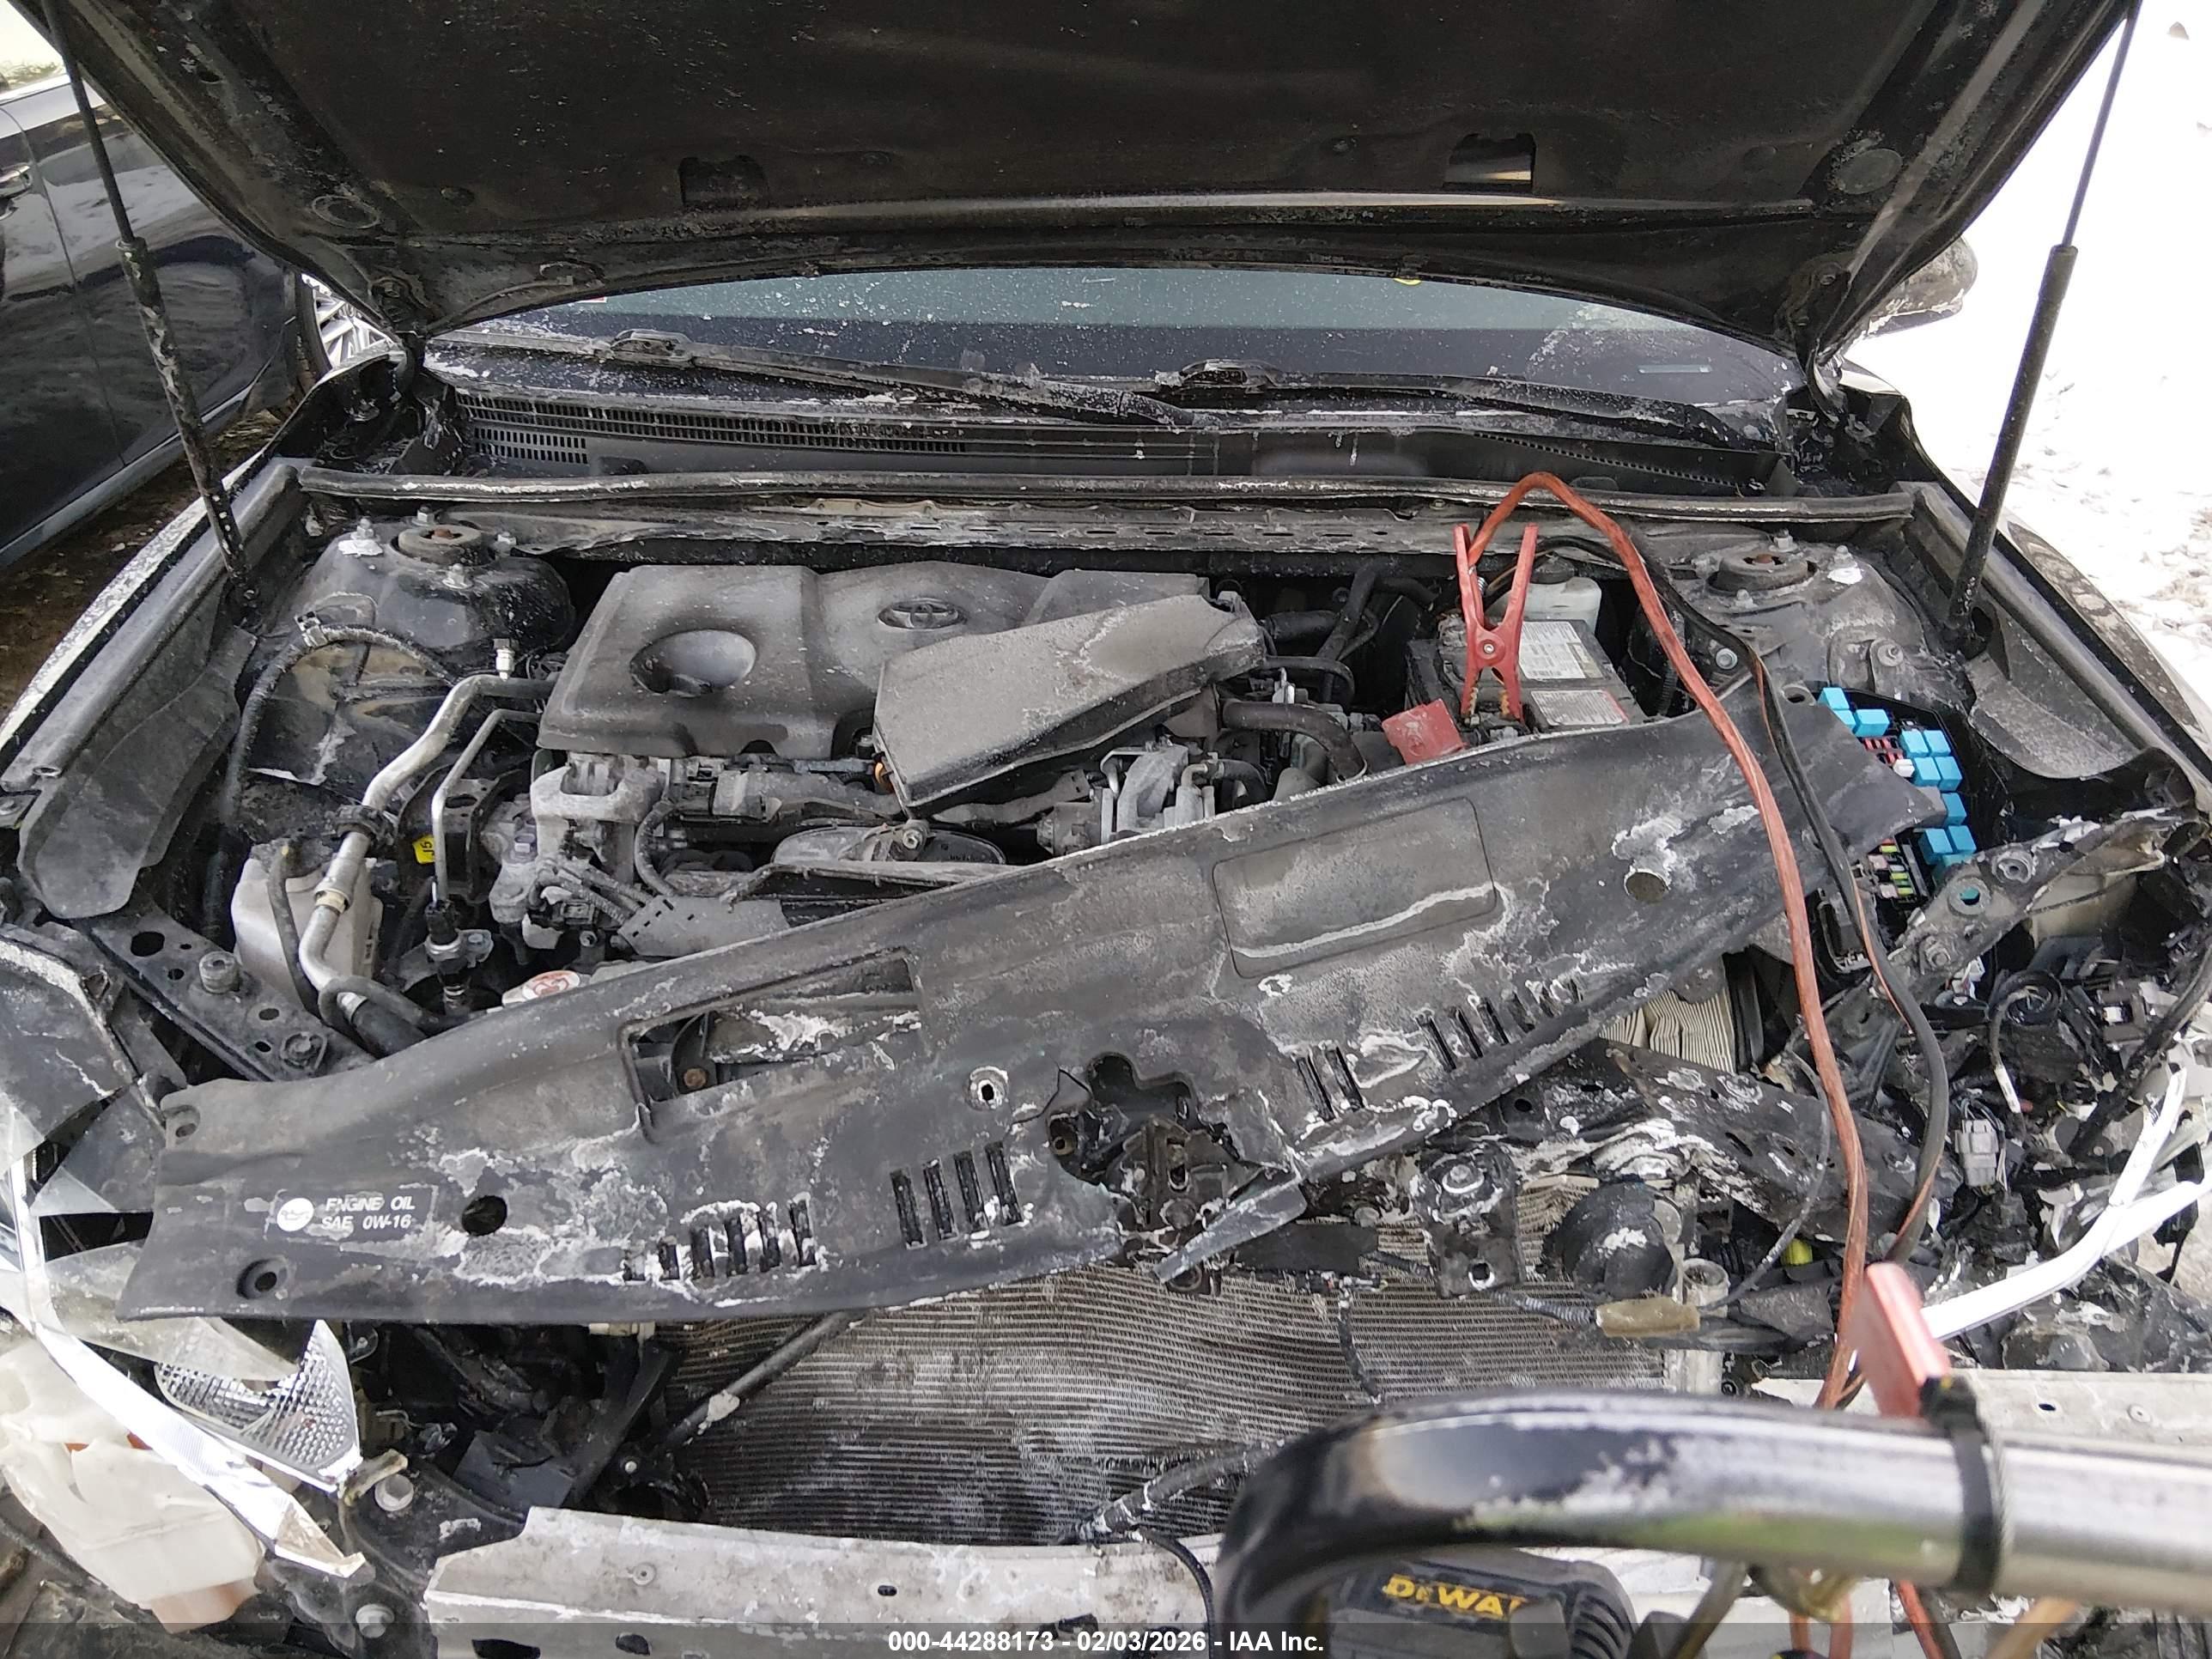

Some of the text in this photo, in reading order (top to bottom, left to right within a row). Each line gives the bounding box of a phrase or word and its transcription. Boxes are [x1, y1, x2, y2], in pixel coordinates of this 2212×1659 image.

[390, 1195, 416, 1211] OIL
[321, 1213, 412, 1231] SAE 0W-16
